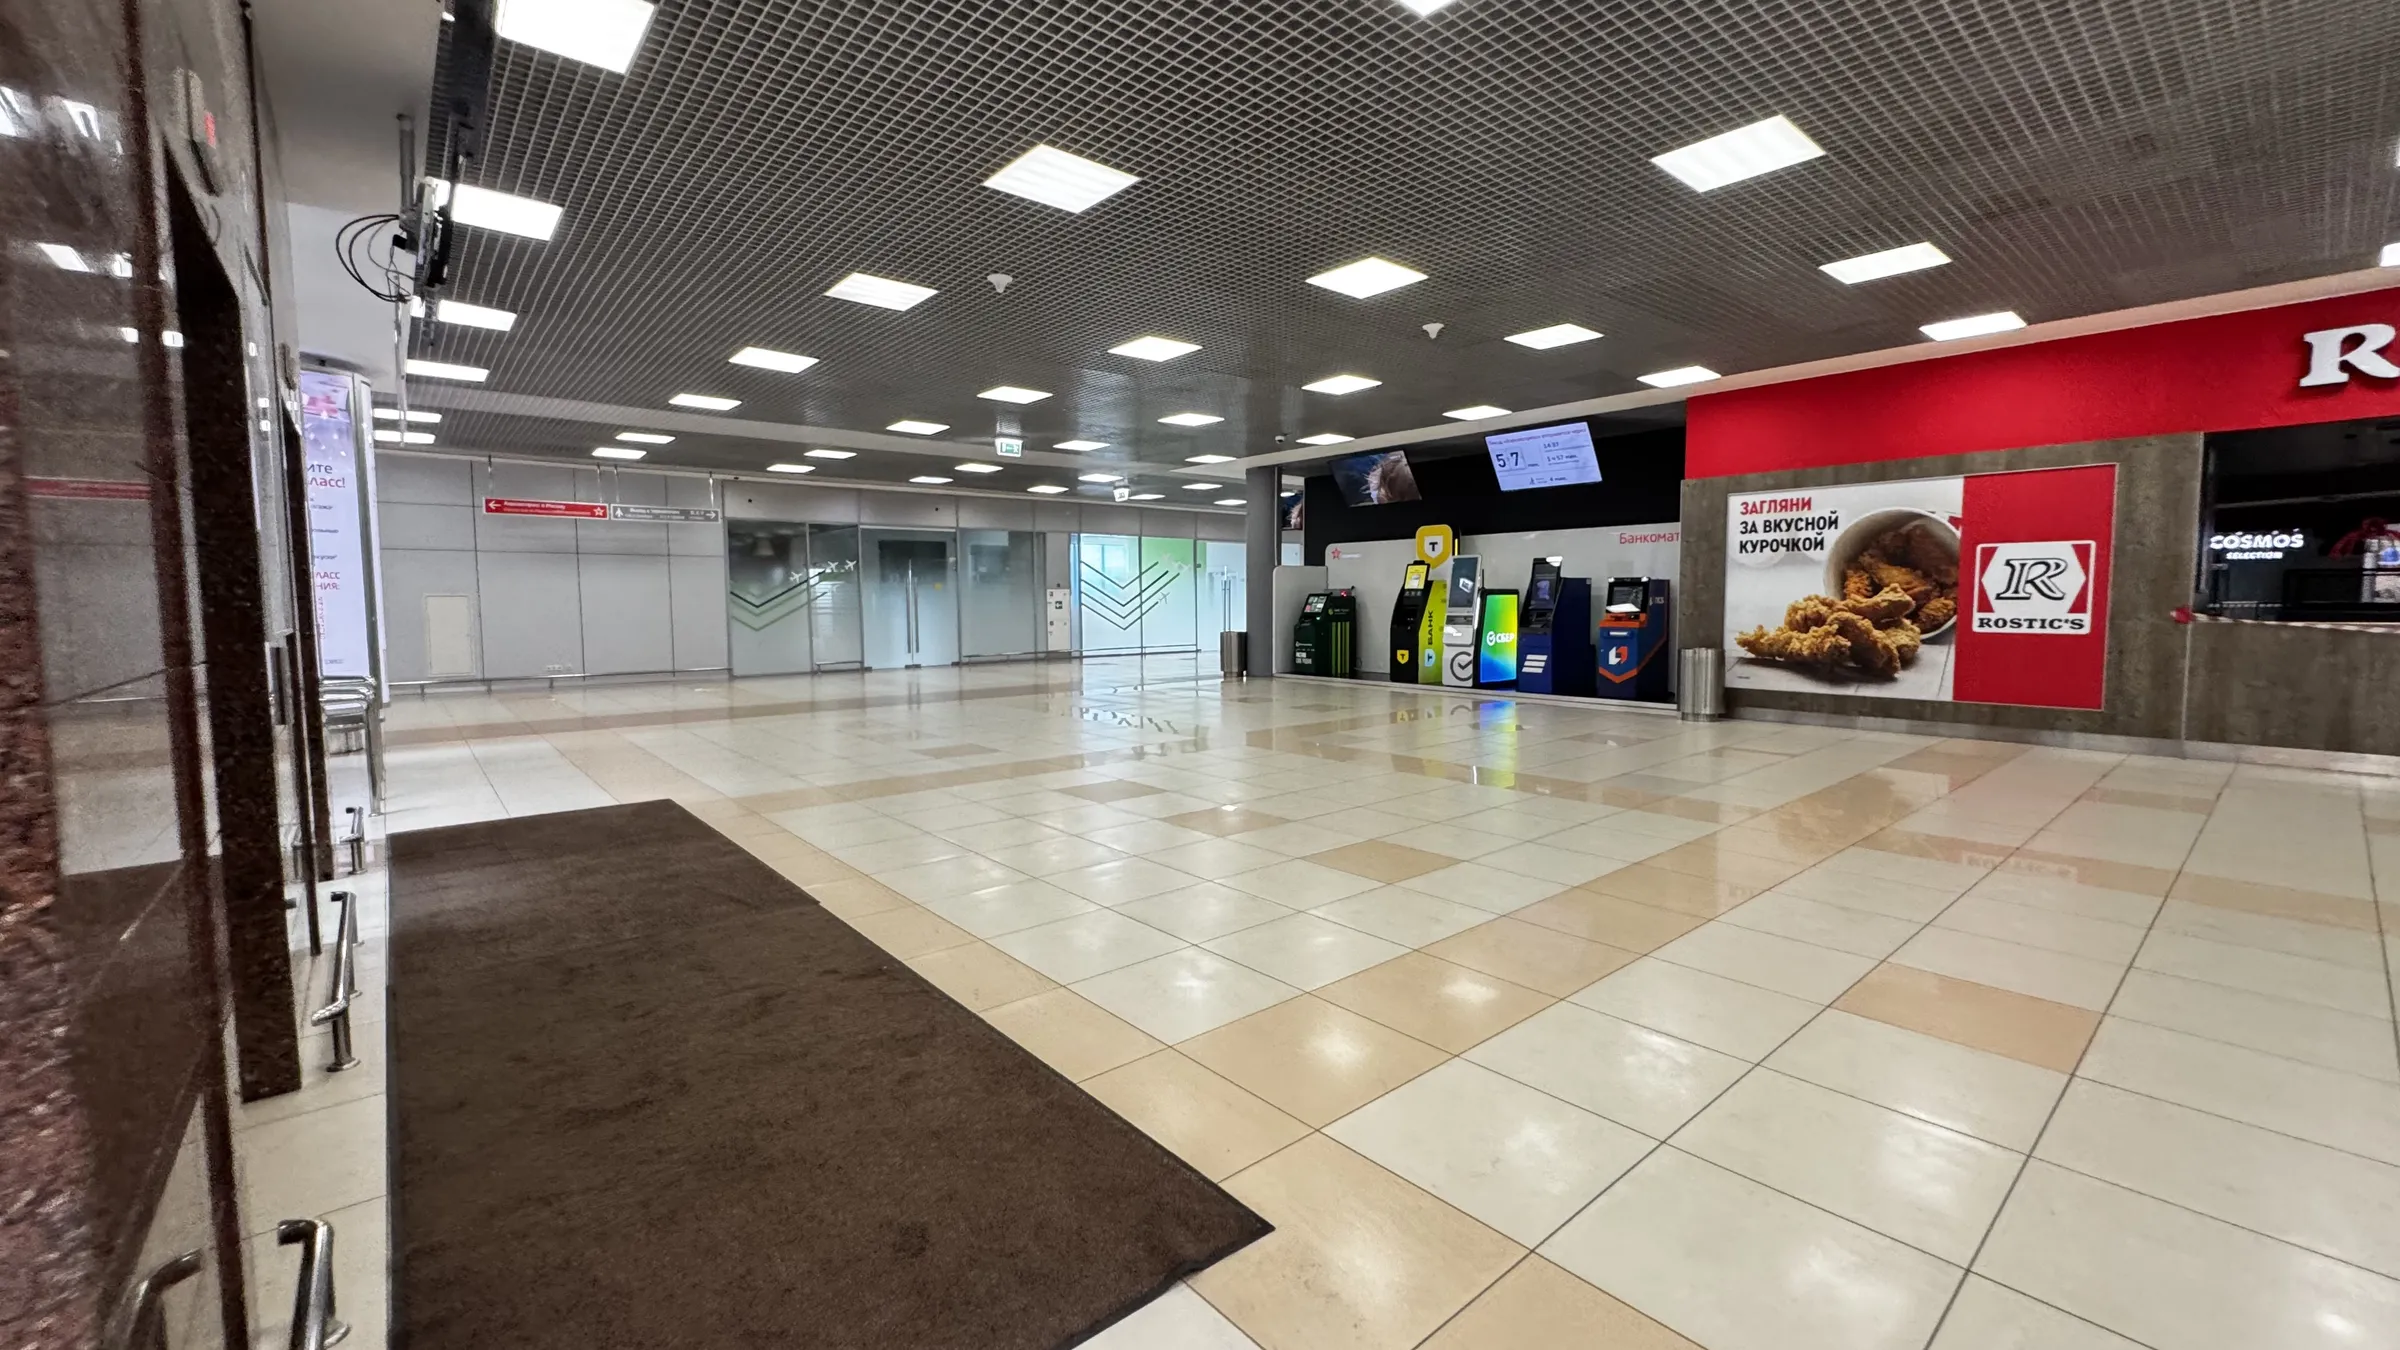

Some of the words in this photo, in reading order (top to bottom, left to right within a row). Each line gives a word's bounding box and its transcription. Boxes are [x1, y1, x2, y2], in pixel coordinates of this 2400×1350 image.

[1740, 497, 1812, 515] ЗАГЛЯНИ
[1740, 520, 1758, 534] ЗА
[1763, 510, 1839, 533] ВКУСНОЙ
[1739, 532, 1824, 554] КУРОЧКОЙ
[2226, 551, 2283, 559] SELECTION
[1977, 617, 2085, 630] ROSTIC'S
